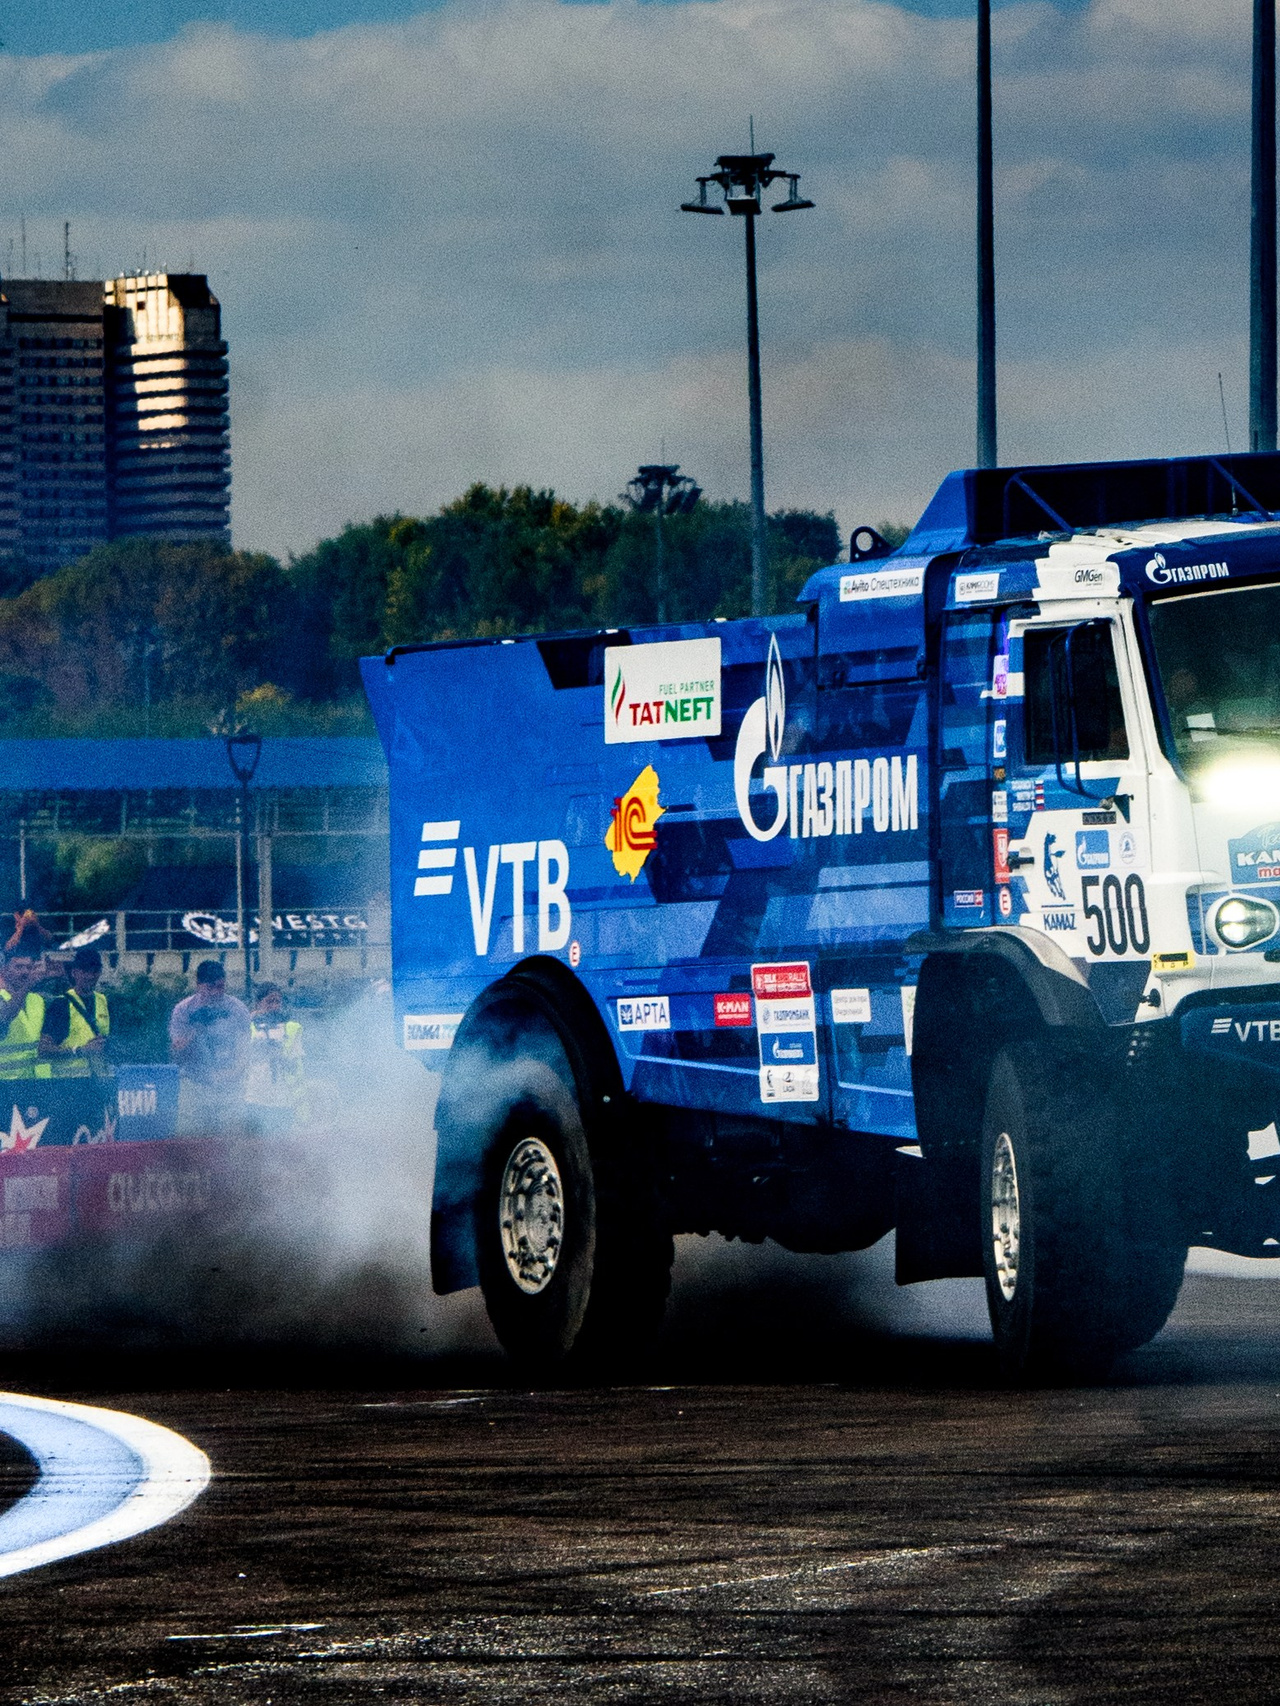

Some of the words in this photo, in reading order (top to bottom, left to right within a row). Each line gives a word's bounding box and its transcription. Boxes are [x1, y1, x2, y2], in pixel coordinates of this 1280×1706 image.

[1171, 562, 1230, 583] ГАЗПРОМ
[659, 683, 678, 696] FUEL
[680, 680, 715, 694] PARTNER
[629, 696, 715, 727] TATNEFT
[789, 754, 919, 839] ГАЗПРОМ
[463, 839, 572, 956] VTB
[1043, 913, 1077, 930] KAMAZ
[1081, 873, 1150, 956] 500
